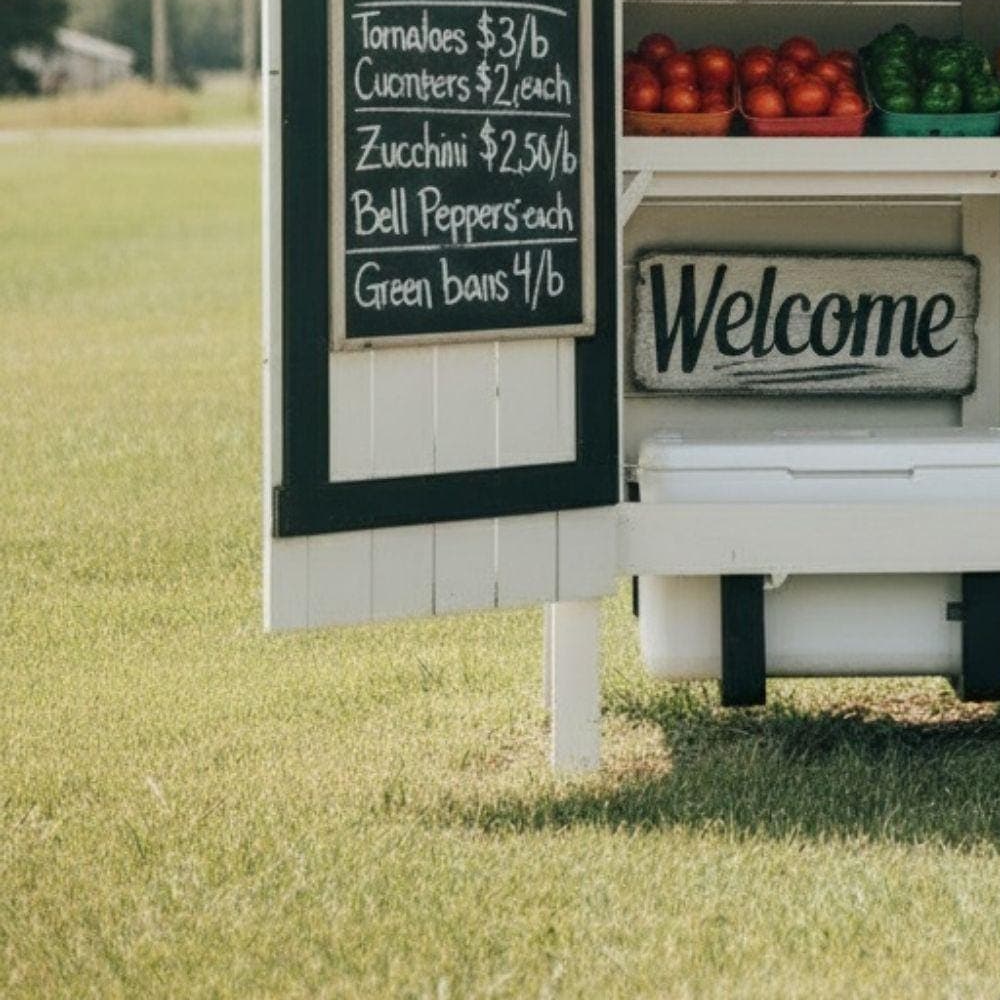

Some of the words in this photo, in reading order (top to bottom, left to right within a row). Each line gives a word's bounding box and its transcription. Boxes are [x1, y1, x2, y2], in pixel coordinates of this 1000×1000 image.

[351, 187, 408, 235] Bell
[355, 261, 432, 310] Green
[650, 263, 958, 374] Welcome
